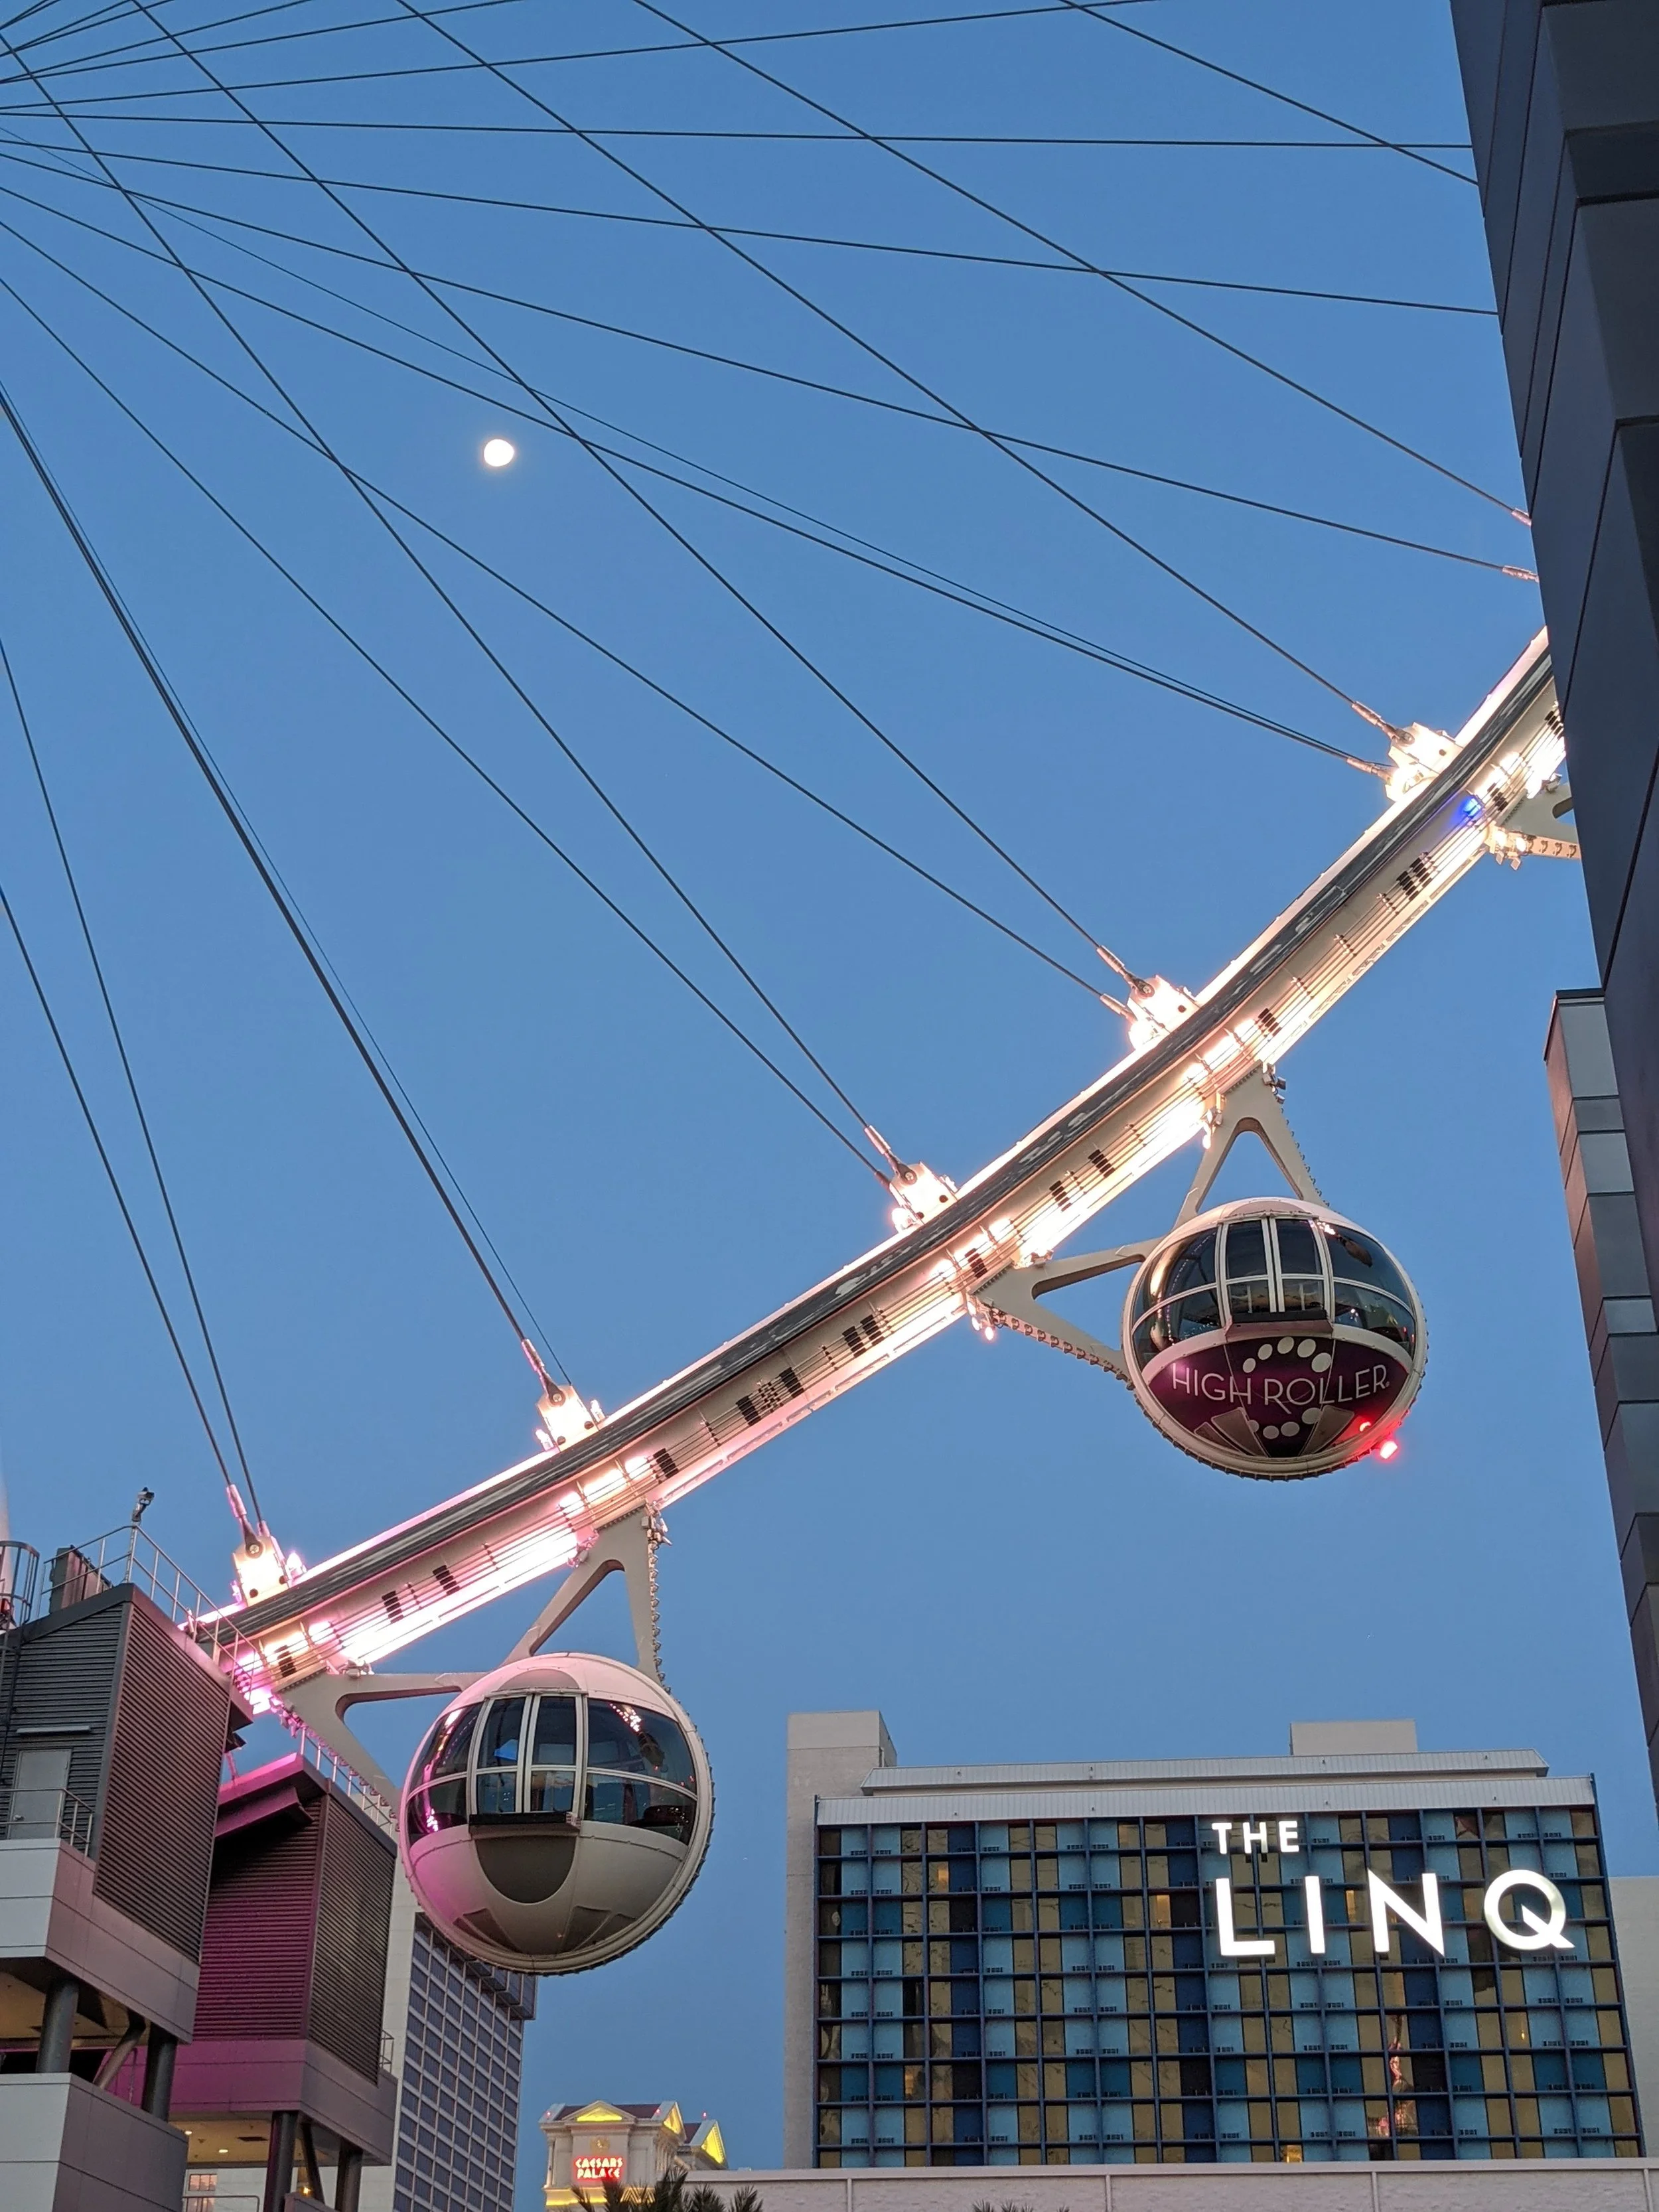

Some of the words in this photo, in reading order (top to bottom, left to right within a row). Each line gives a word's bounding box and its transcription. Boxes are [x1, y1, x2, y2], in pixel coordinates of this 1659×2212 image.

[1172, 1363, 1252, 1405] HIGH
[1264, 1364, 1388, 1414] ROLLER
[1211, 1820, 1300, 1854] THE
[1215, 1868, 1575, 1956] LINQ
[575, 2158, 623, 2168] CAESARS
[577, 2168, 620, 2179] PALACE
